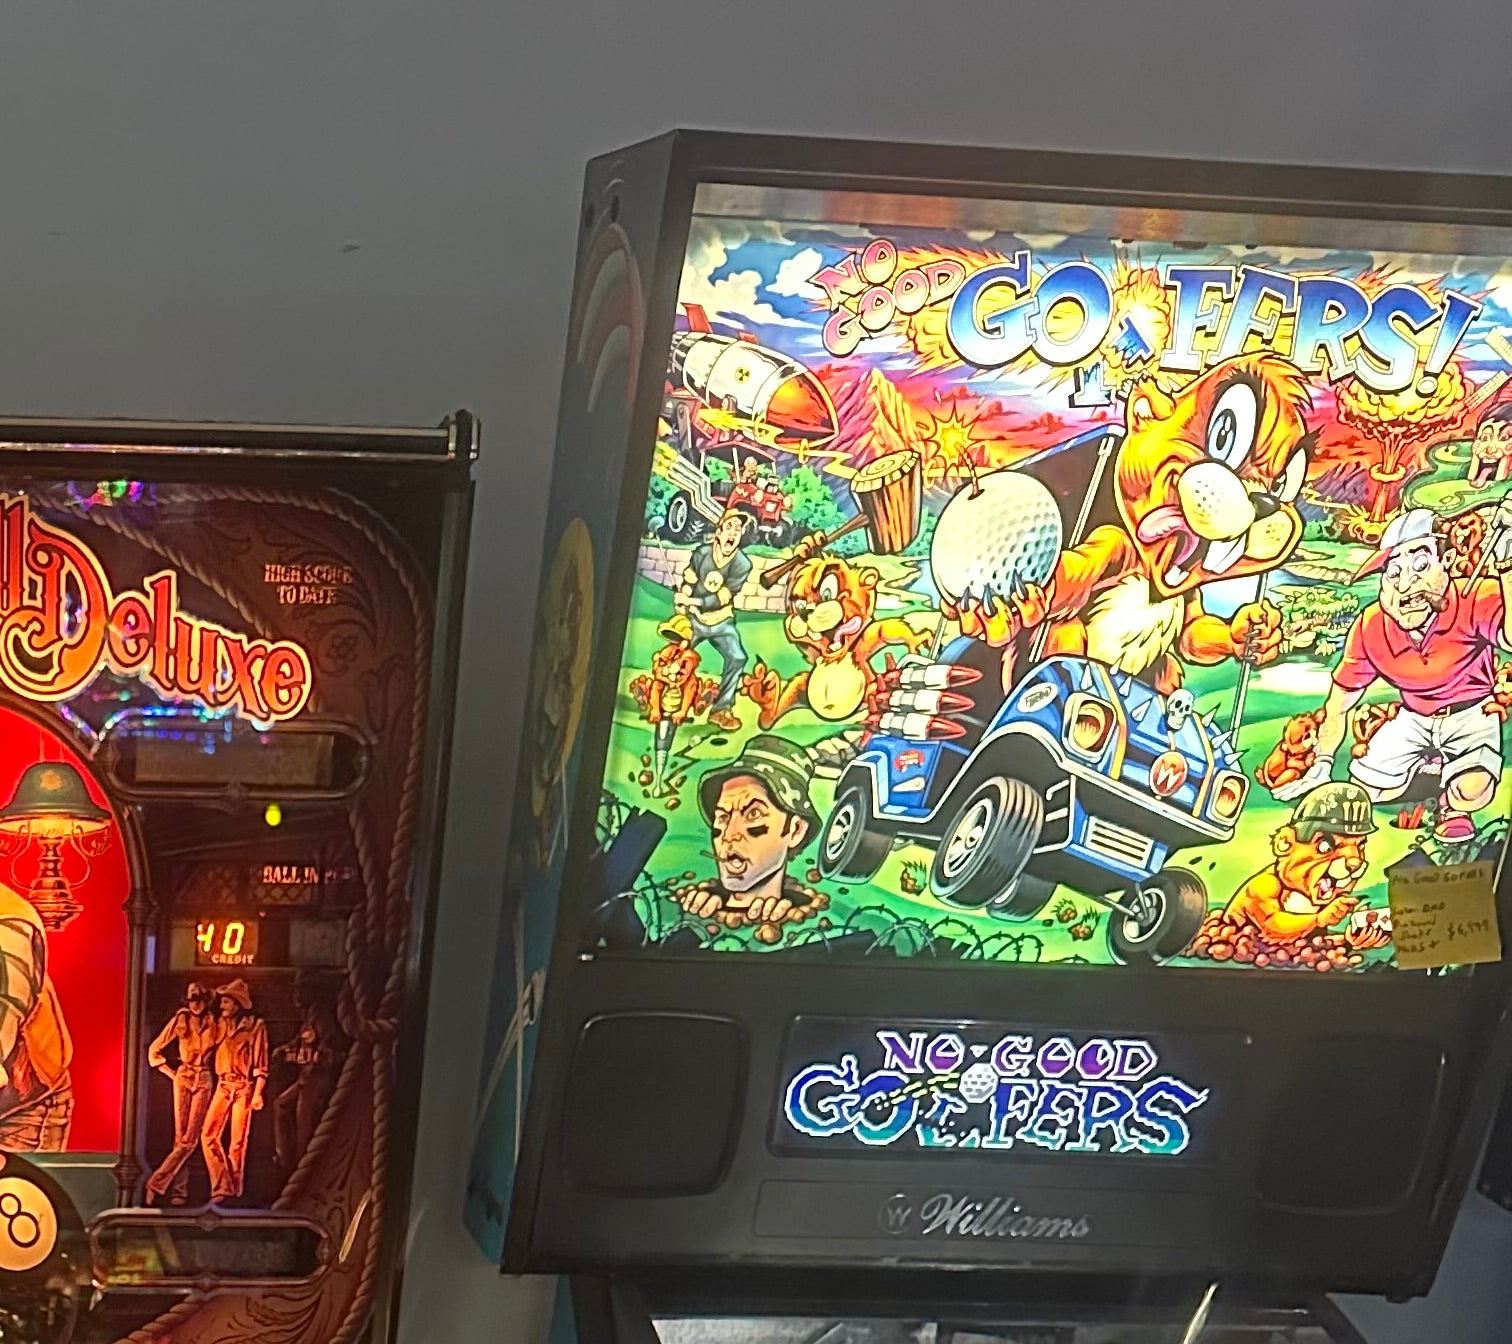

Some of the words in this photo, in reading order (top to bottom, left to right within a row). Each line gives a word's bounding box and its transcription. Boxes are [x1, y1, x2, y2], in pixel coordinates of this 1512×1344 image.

[810, 239, 899, 312] NO
[821, 261, 966, 357] GOOD
[264, 564, 301, 583] HIGH
[276, 585, 297, 604] TO
[299, 586, 338, 604] DATE
[1153, 758, 1186, 787] W
[263, 866, 301, 884] BALL
[211, 953, 255, 965] CREDIT
[876, 1031, 966, 1075] NO
[990, 1035, 1159, 1082] GOOD
[920, 1193, 1092, 1240] Williams
